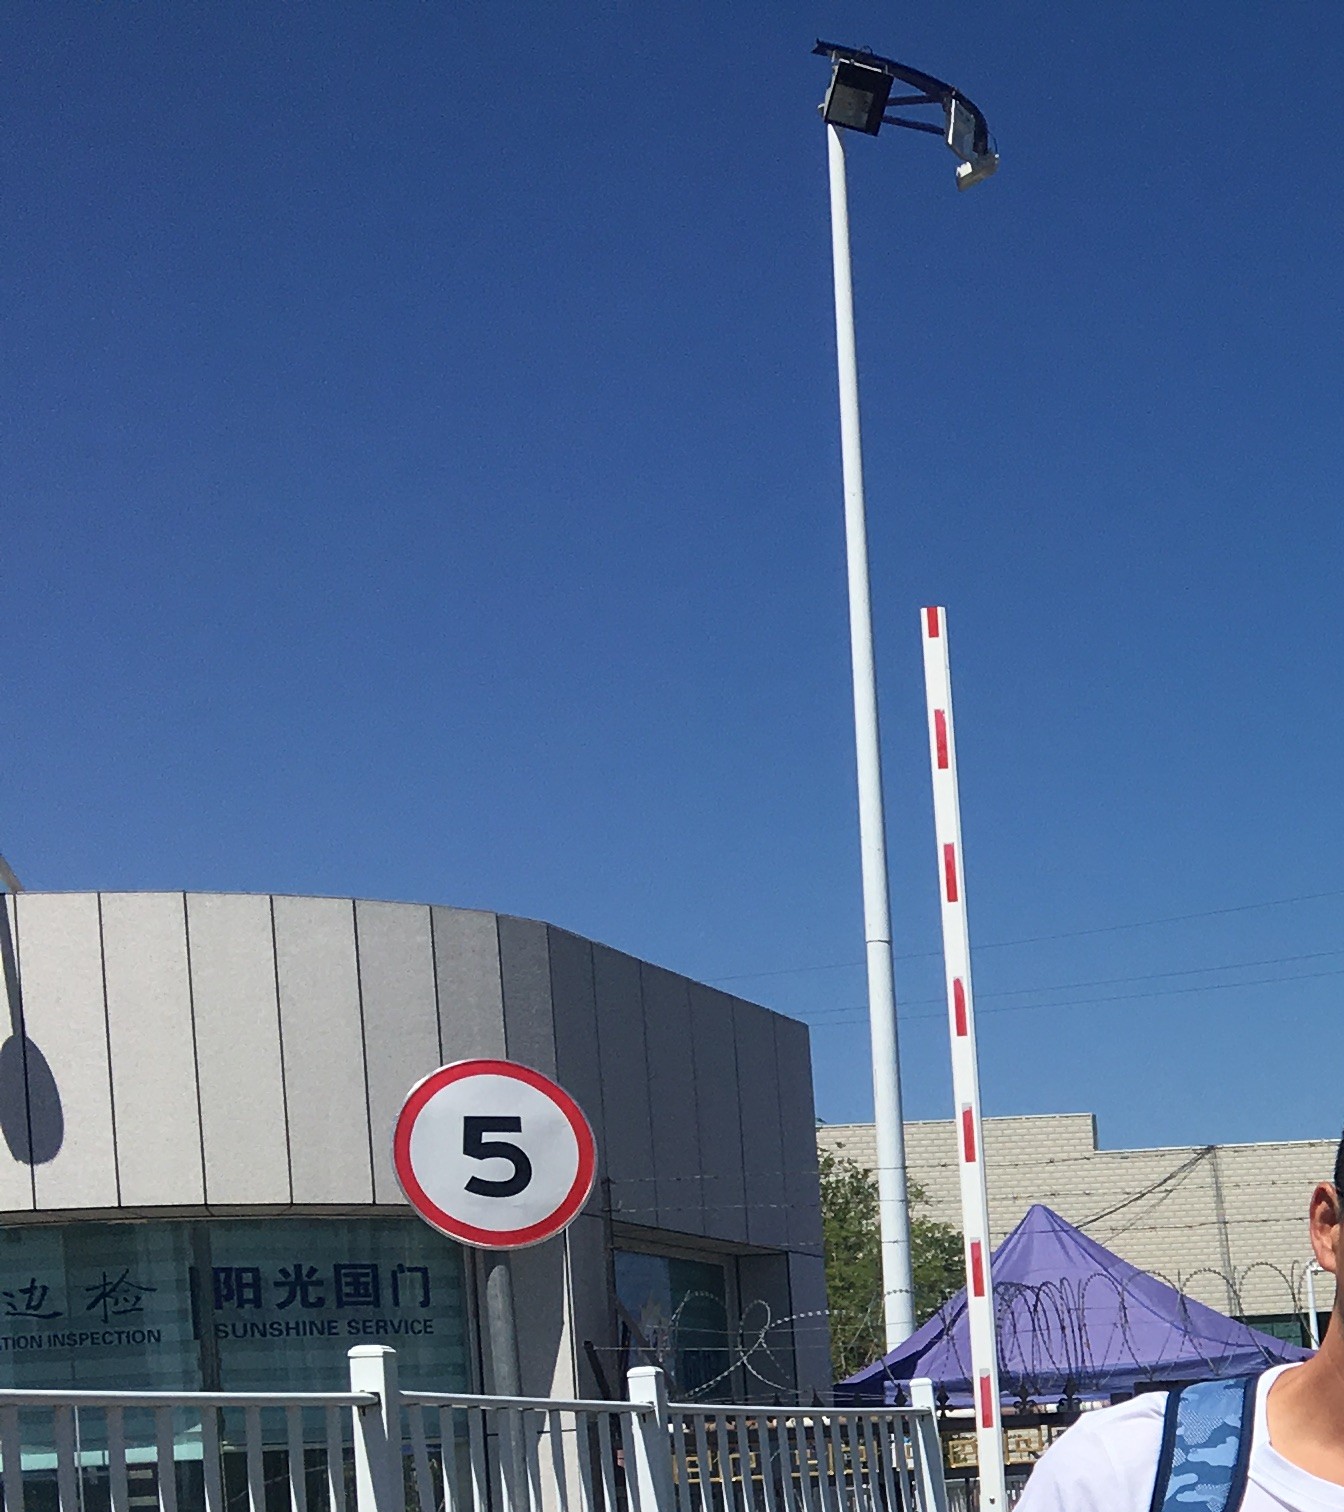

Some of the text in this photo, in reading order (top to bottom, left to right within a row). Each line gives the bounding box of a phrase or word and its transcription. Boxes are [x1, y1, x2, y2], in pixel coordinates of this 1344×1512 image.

[462, 1115, 533, 1198] 5
[212, 1263, 431, 1311] 阳光国门
[0, 1329, 161, 1351] TION INSPECTION
[215, 1318, 435, 1340] SUNSHINE SERVICE
